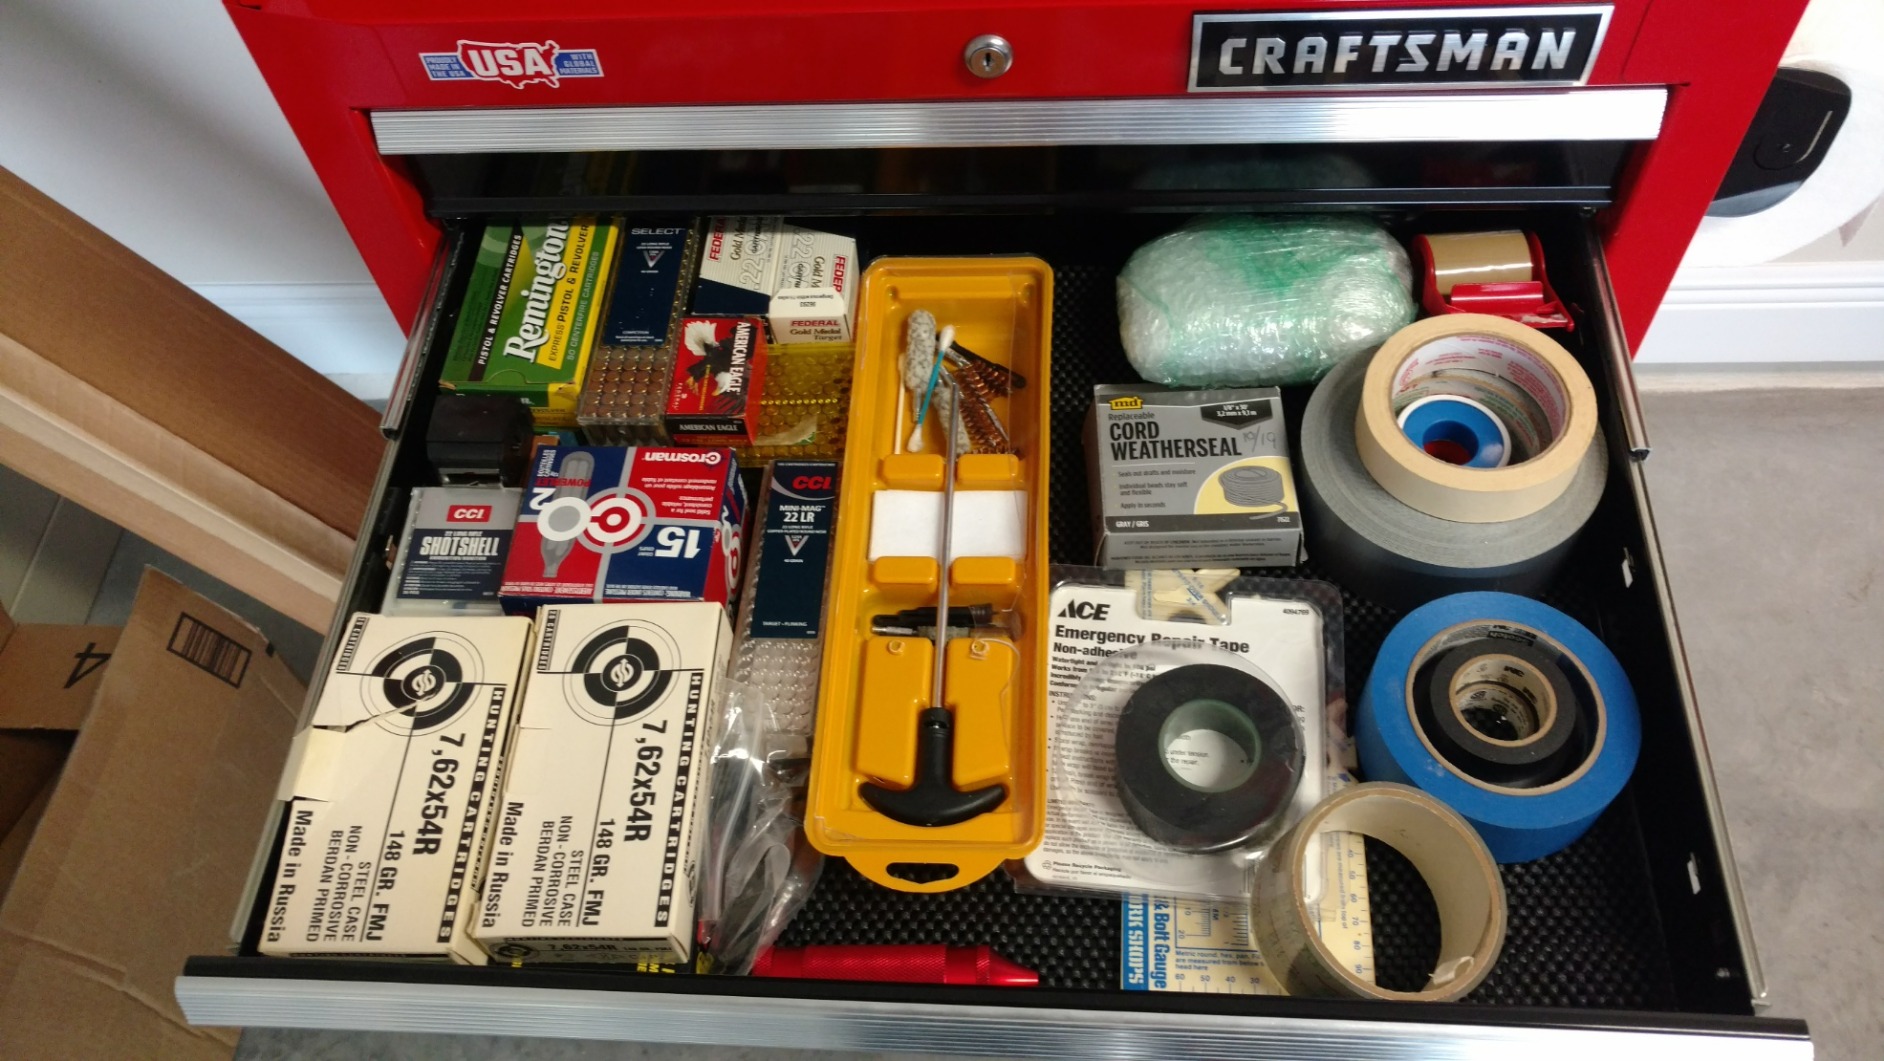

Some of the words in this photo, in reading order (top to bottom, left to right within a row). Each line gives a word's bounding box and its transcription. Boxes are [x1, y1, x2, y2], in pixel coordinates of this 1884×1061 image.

[467, 48, 553, 77] USA
[1218, 29, 1577, 75] CRAFTSMAN
[630, 227, 682, 235] SELECT
[709, 217, 728, 261] FEDERA
[569, 224, 590, 274] REVOLVER
[730, 237, 744, 261] Gold
[812, 255, 826, 278] Gold
[832, 255, 846, 293] FEDER
[477, 336, 492, 365] PISTOL
[493, 285, 507, 326] REVOLVER
[501, 233, 523, 283] CARTRIDGES
[502, 221, 570, 364] Remington
[556, 288, 574, 323] PISTOL
[570, 300, 588, 347] CENTERFIRE
[582, 251, 600, 298] CARTRIDGES
[789, 328, 812, 336] Gold
[813, 327, 842, 336] Medal
[790, 319, 841, 327] FEDERAL
[548, 322, 565, 362] EXPRESS
[734, 321, 752, 364] AMERICAN
[727, 366, 746, 393] EAGLE
[1108, 411, 1155, 422] Replaceable
[1113, 397, 1140, 408] md
[716, 424, 738, 432] EAGLE
[1109, 420, 1160, 442] CORD
[644, 451, 722, 466] Crosman
[1110, 436, 1243, 461] WEATHERSEAL
[791, 475, 832, 490] CCI
[453, 508, 485, 519] CCI
[783, 511, 799, 523] 22
[799, 511, 815, 523] LR
[1115, 520, 1132, 528] GRAY
[419, 536, 500, 556] SHOTSHELL
[654, 526, 702, 559] 15
[1058, 599, 1111, 621] ACE
[537, 621, 555, 671] CARTRIDGES
[1055, 624, 1146, 646] Emergency
[1209, 636, 1250, 654] Tape
[474, 689, 504, 783] HUNTING
[678, 674, 703, 768] HUNTING
[412, 732, 466, 857] 7,62x54R
[623, 719, 668, 842] 7,62x54R
[288, 809, 314, 857] Made
[350, 825, 363, 854] NON
[502, 801, 525, 843] Made
[557, 815, 574, 844] NON
[595, 818, 616, 849] 148
[320, 829, 344, 884] BERDAN
[389, 831, 406, 861] 148
[497, 845, 514, 867] in
[533, 820, 555, 873] BERDAN
[656, 774, 687, 924] CARTRIDGES
[284, 861, 302, 878] in
[353, 861, 372, 903] STEEL
[375, 865, 398, 897] GR.
[438, 790, 482, 939] CARTRIDGES
[565, 850, 584, 889] STEEL
[588, 852, 611, 883] GR.
[324, 864, 353, 942] CORROSIVE
[481, 871, 510, 929] Russia
[521, 876, 545, 928] PRIMED
[538, 851, 566, 928] CORROSIVE
[267, 884, 296, 943] Russia
[306, 889, 330, 942] PRIMED
[342, 906, 362, 942] CASE
[366, 903, 390, 942] FMJ
[557, 892, 576, 927] CASE
[582, 889, 605, 927] FMJ
[1127, 893, 1145, 927] ORK
[1153, 912, 1171, 942] Bolt
[1127, 929, 1145, 985] SHOPS
[1150, 943, 1171, 989] Gauge
